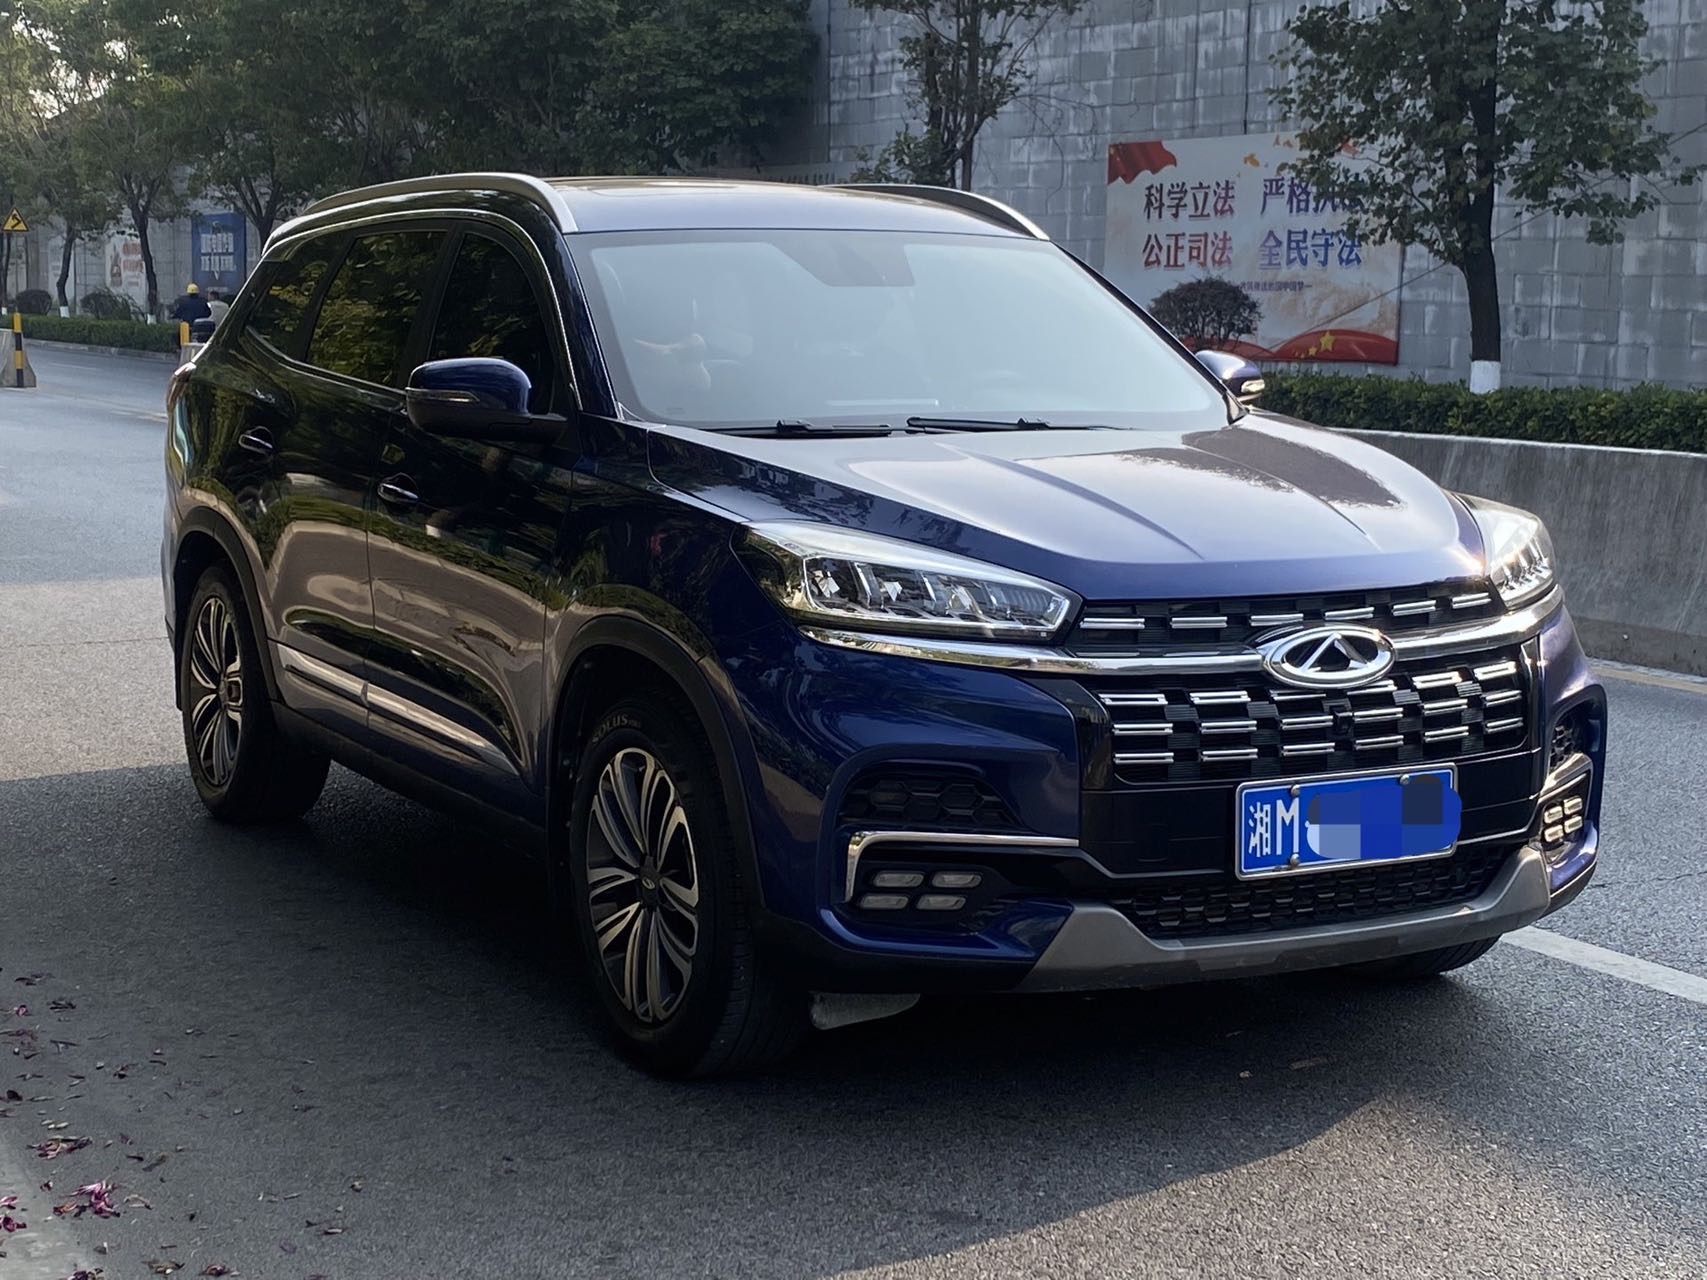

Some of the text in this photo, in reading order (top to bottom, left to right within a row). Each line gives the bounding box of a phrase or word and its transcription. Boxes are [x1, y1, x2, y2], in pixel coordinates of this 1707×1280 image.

[1143, 179, 1235, 219] 科学立法
[1142, 228, 1362, 269] 公正司法 全民守法
